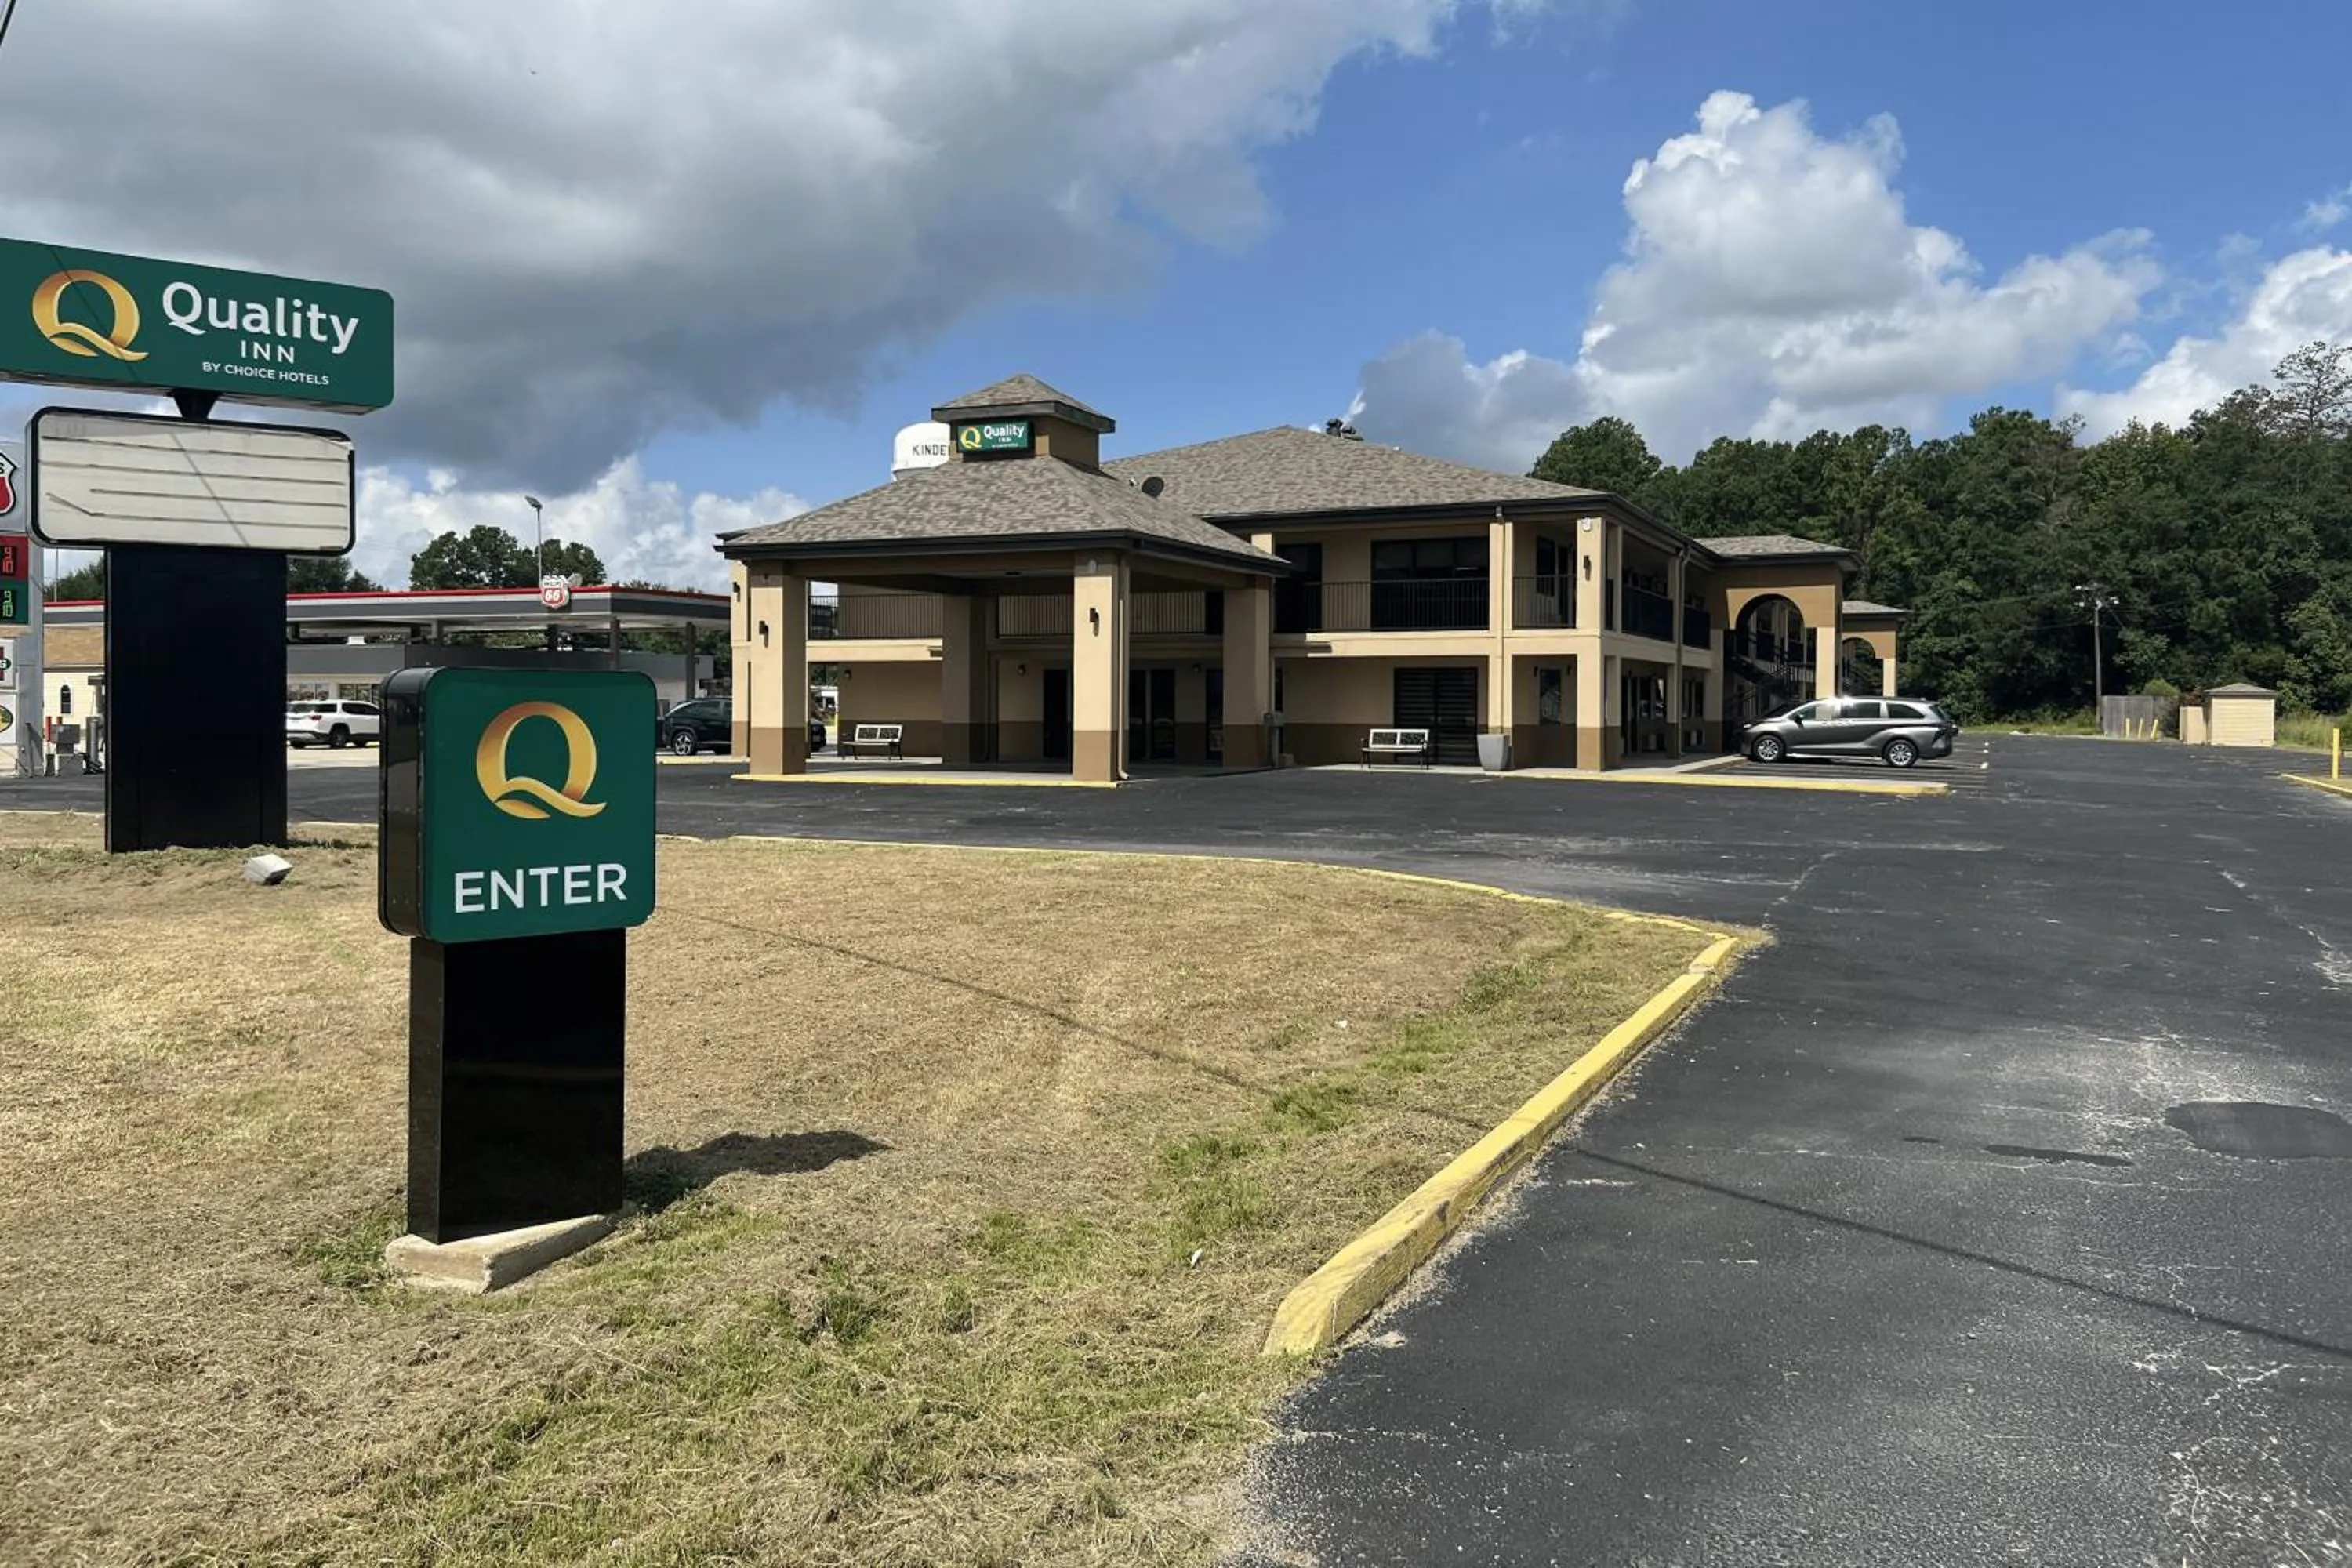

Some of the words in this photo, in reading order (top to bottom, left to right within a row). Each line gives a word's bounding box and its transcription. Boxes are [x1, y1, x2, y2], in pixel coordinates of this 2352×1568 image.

[32, 269, 149, 361] Q
[162, 281, 359, 354] Quality
[241, 340, 295, 364] INN
[202, 361, 220, 372] BY
[225, 364, 275, 379] CHOICE
[278, 371, 329, 385] HOTELS
[983, 424, 1025, 440] Quality
[912, 444, 951, 456] KINDE
[545, 589, 561, 601] 66
[476, 701, 608, 819] Q
[455, 863, 628, 913] ENTER
